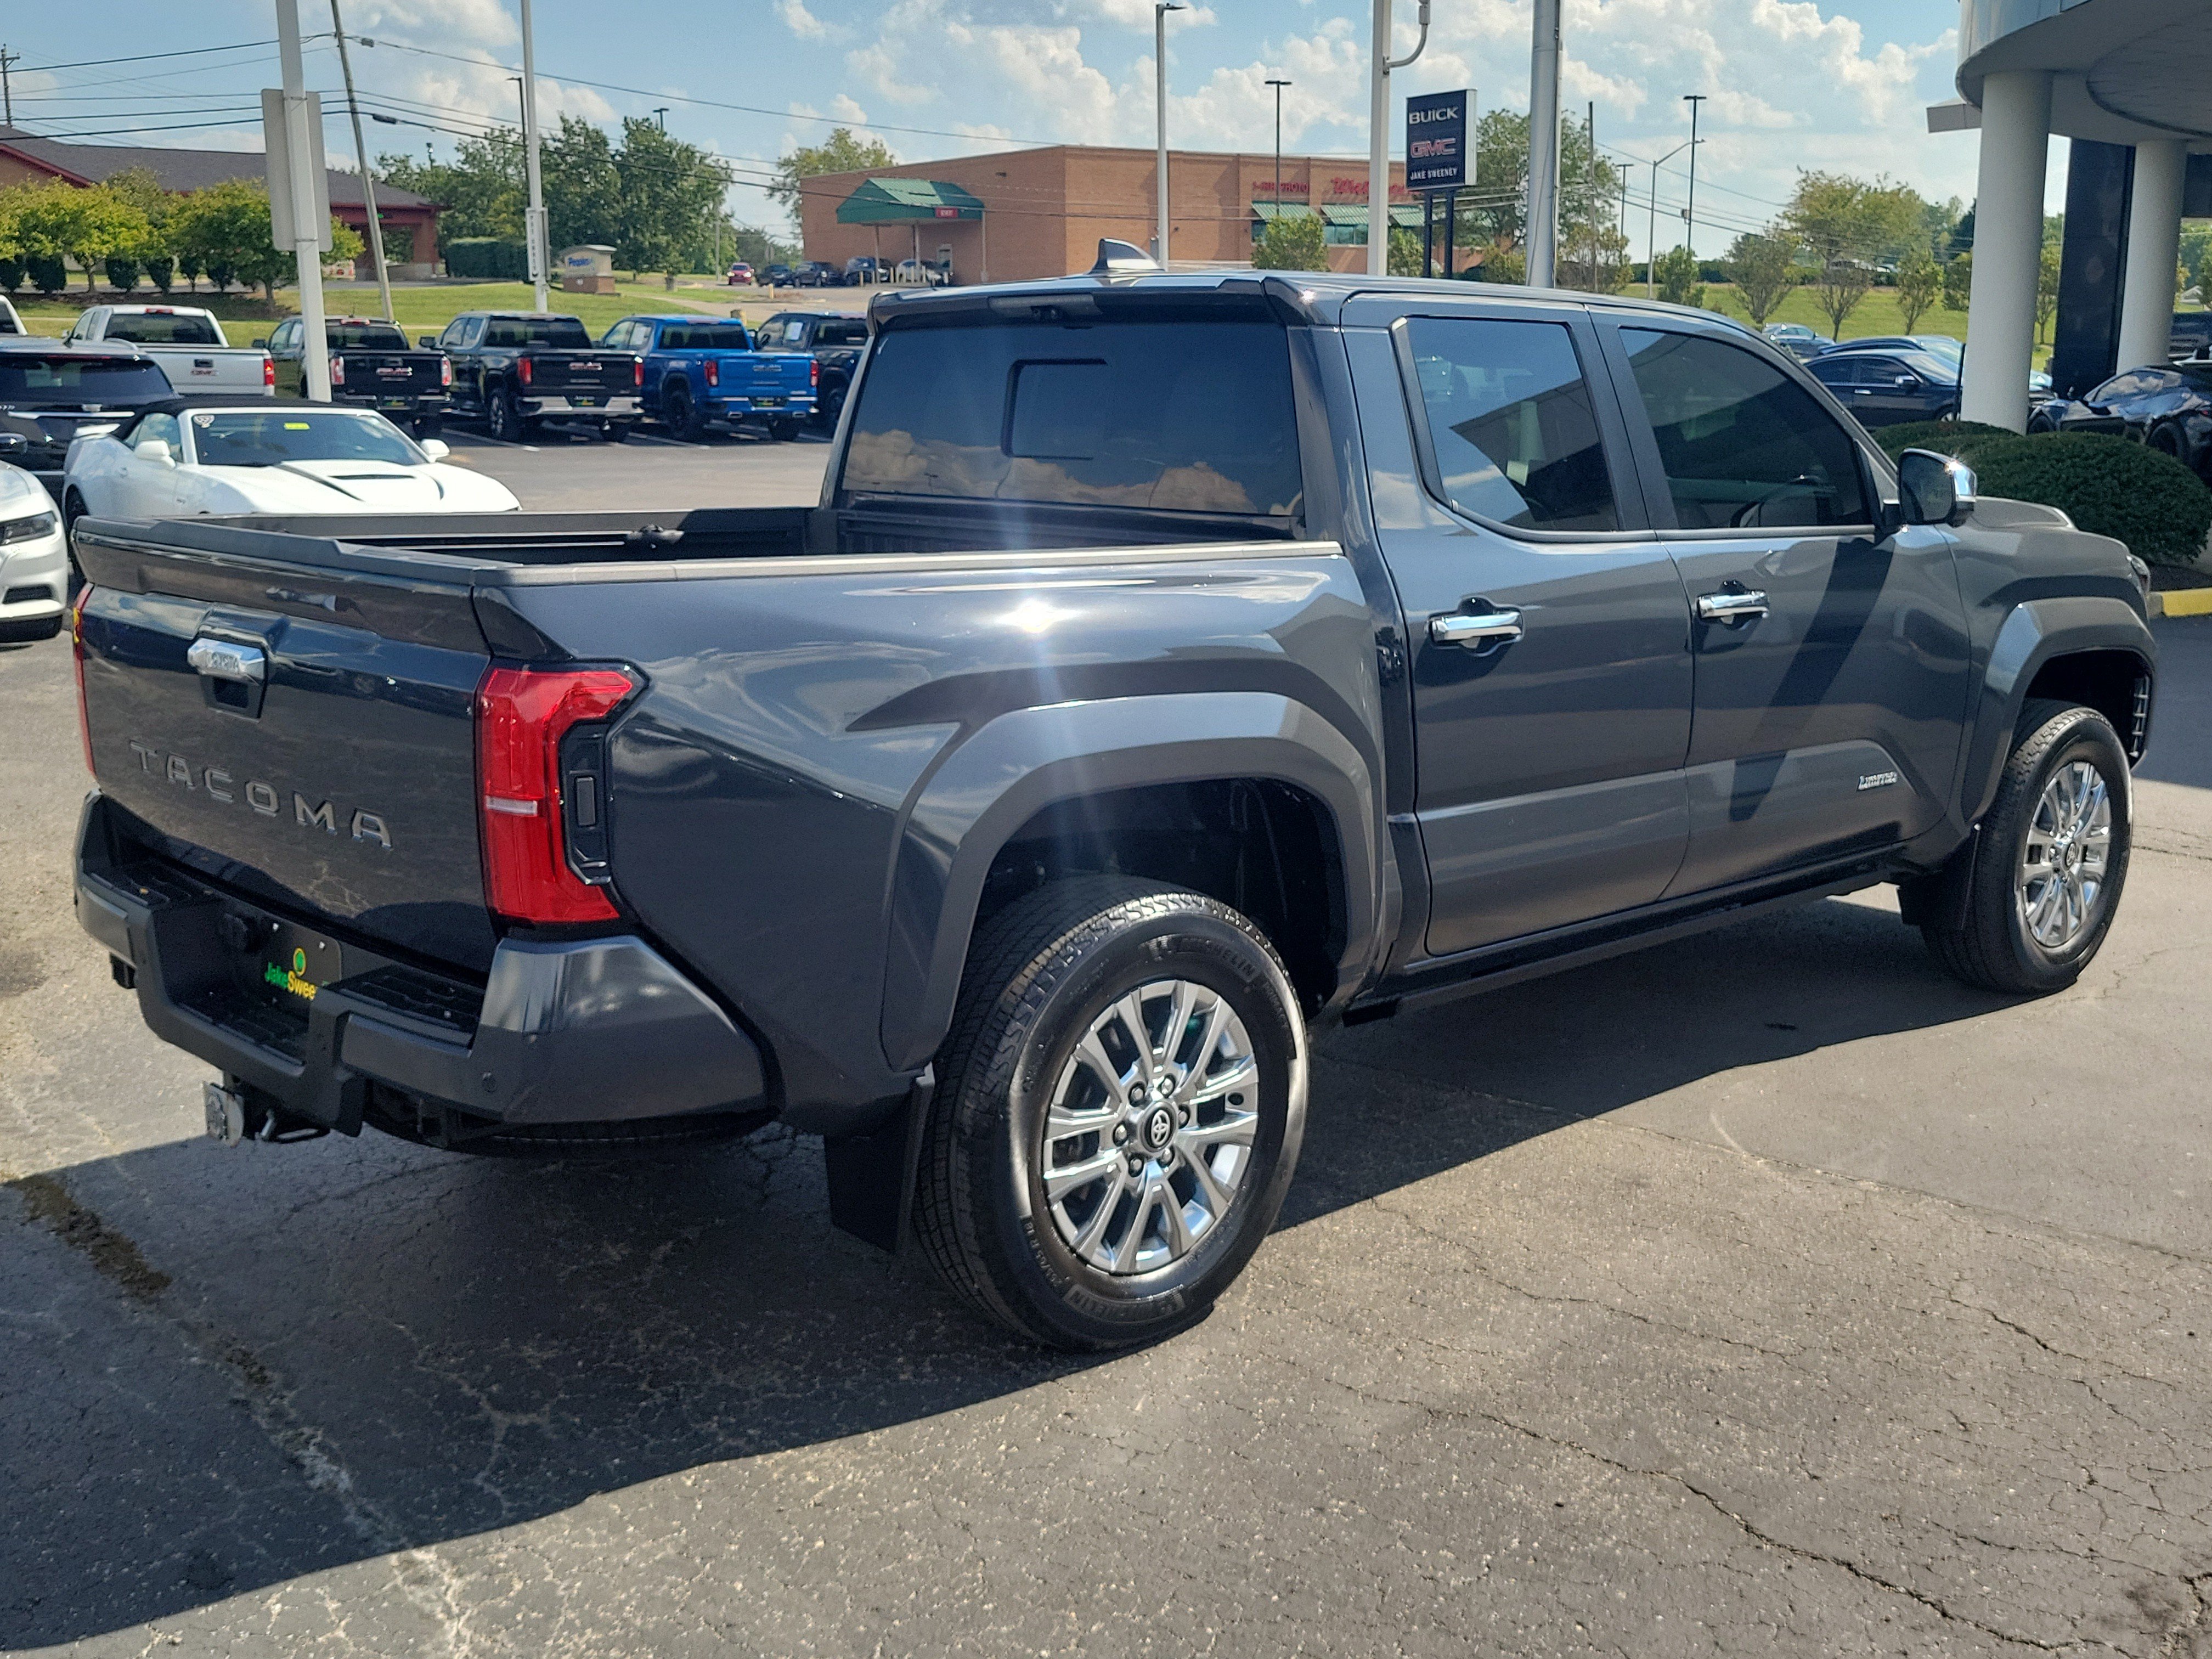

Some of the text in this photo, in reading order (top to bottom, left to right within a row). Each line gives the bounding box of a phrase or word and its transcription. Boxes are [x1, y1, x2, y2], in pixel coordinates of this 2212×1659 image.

[1409, 106, 1458, 125] BUICK
[1410, 138, 1456, 158] GMC
[129, 740, 394, 851] TACOMA
